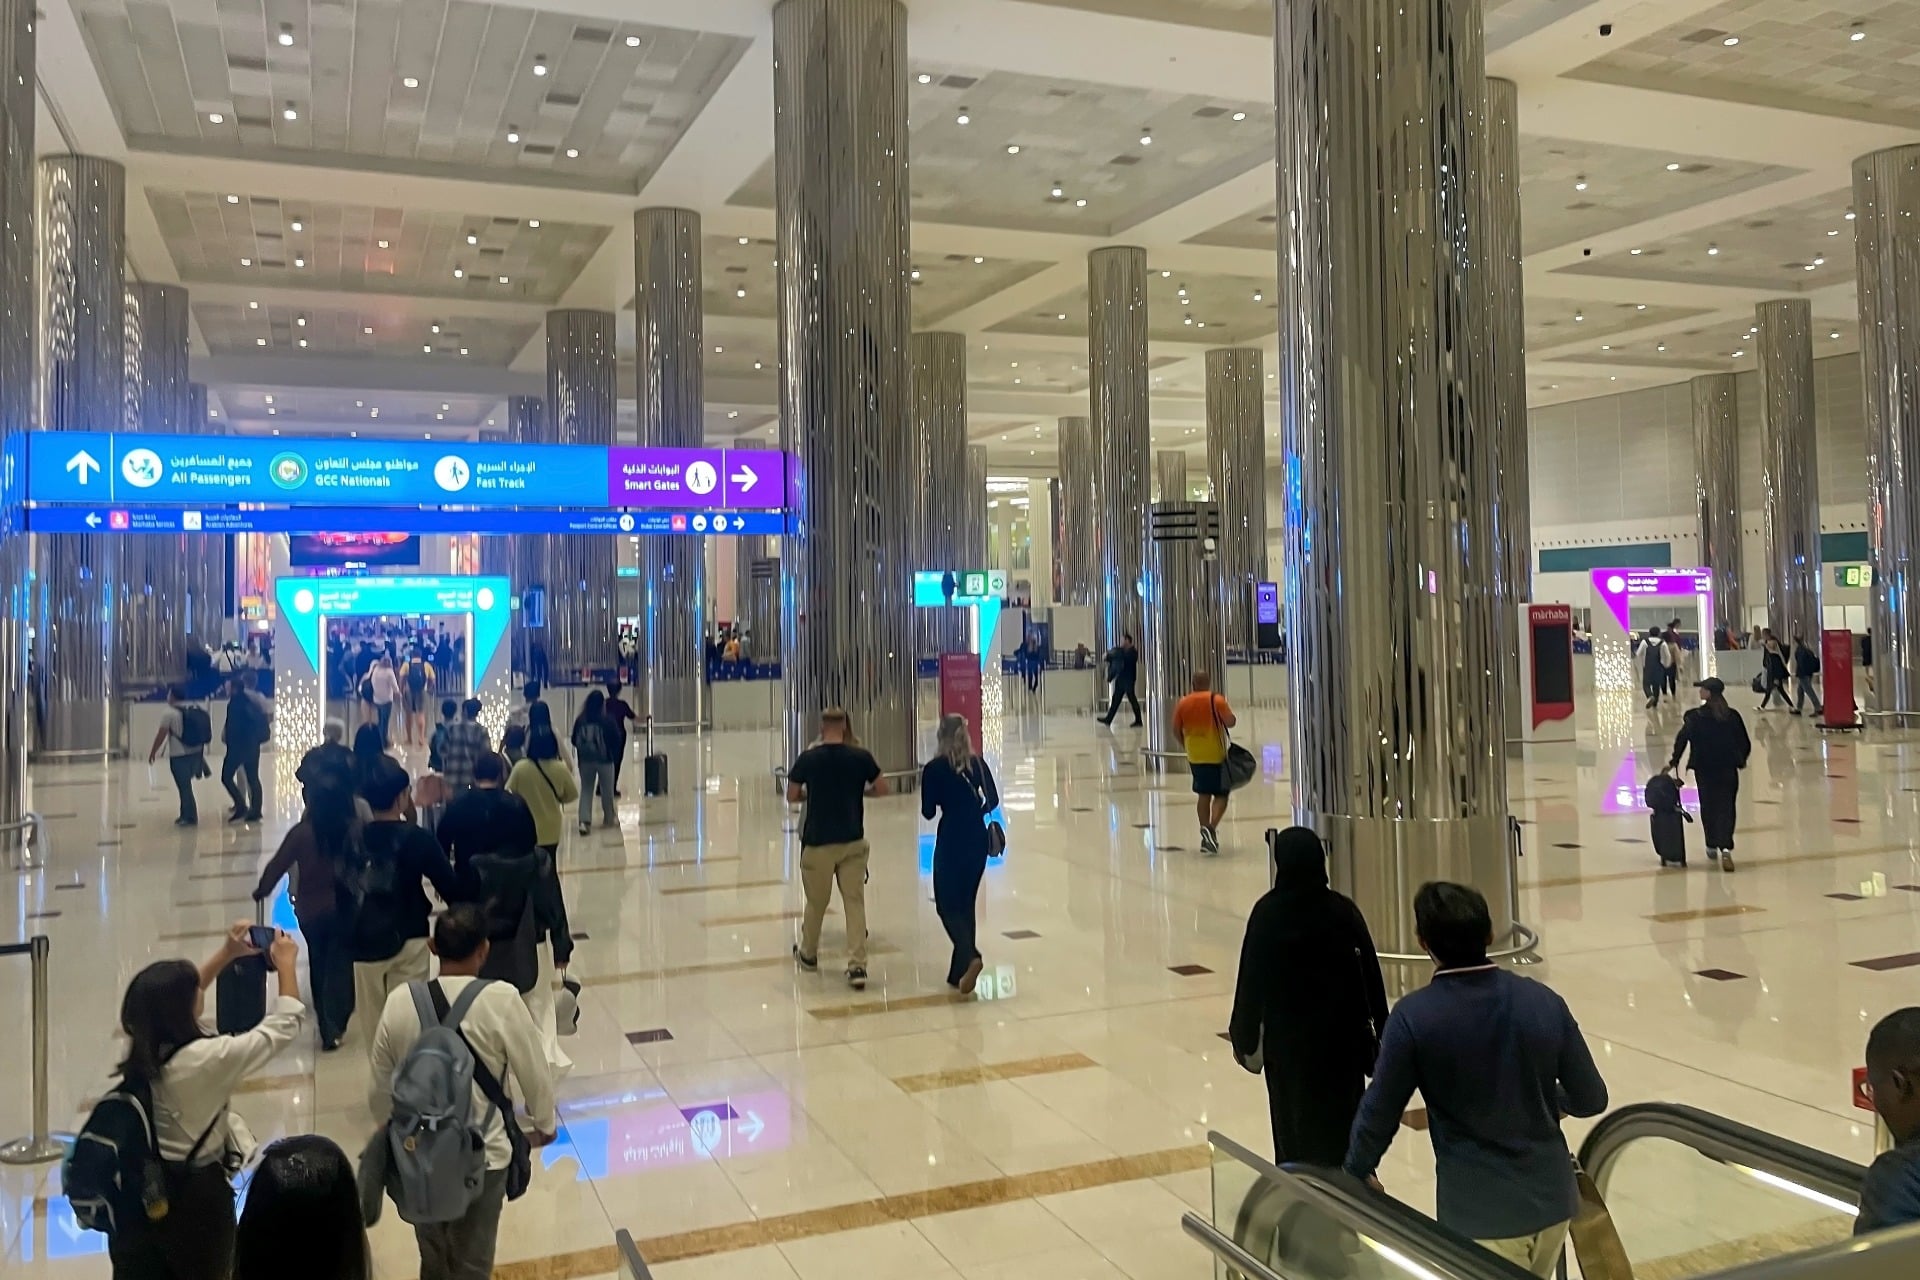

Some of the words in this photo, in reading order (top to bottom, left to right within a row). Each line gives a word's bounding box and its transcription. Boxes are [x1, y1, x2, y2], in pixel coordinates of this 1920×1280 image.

[171, 454, 226, 468] المسافرين
[228, 457, 253, 471] جميع
[315, 457, 350, 471] التعاون
[352, 458, 383, 471] مجلس
[476, 461, 507, 475] السريع
[622, 463, 646, 476] الذكية
[648, 463, 680, 476] البوابات
[172, 472, 188, 484] All
[191, 472, 251, 487] Passengers
[315, 474, 339, 487] GCC
[341, 475, 391, 487] Nationals
[476, 476, 497, 489] Fast
[498, 477, 525, 489] Track
[625, 479, 652, 491] Smart
[654, 479, 680, 491] Gates
